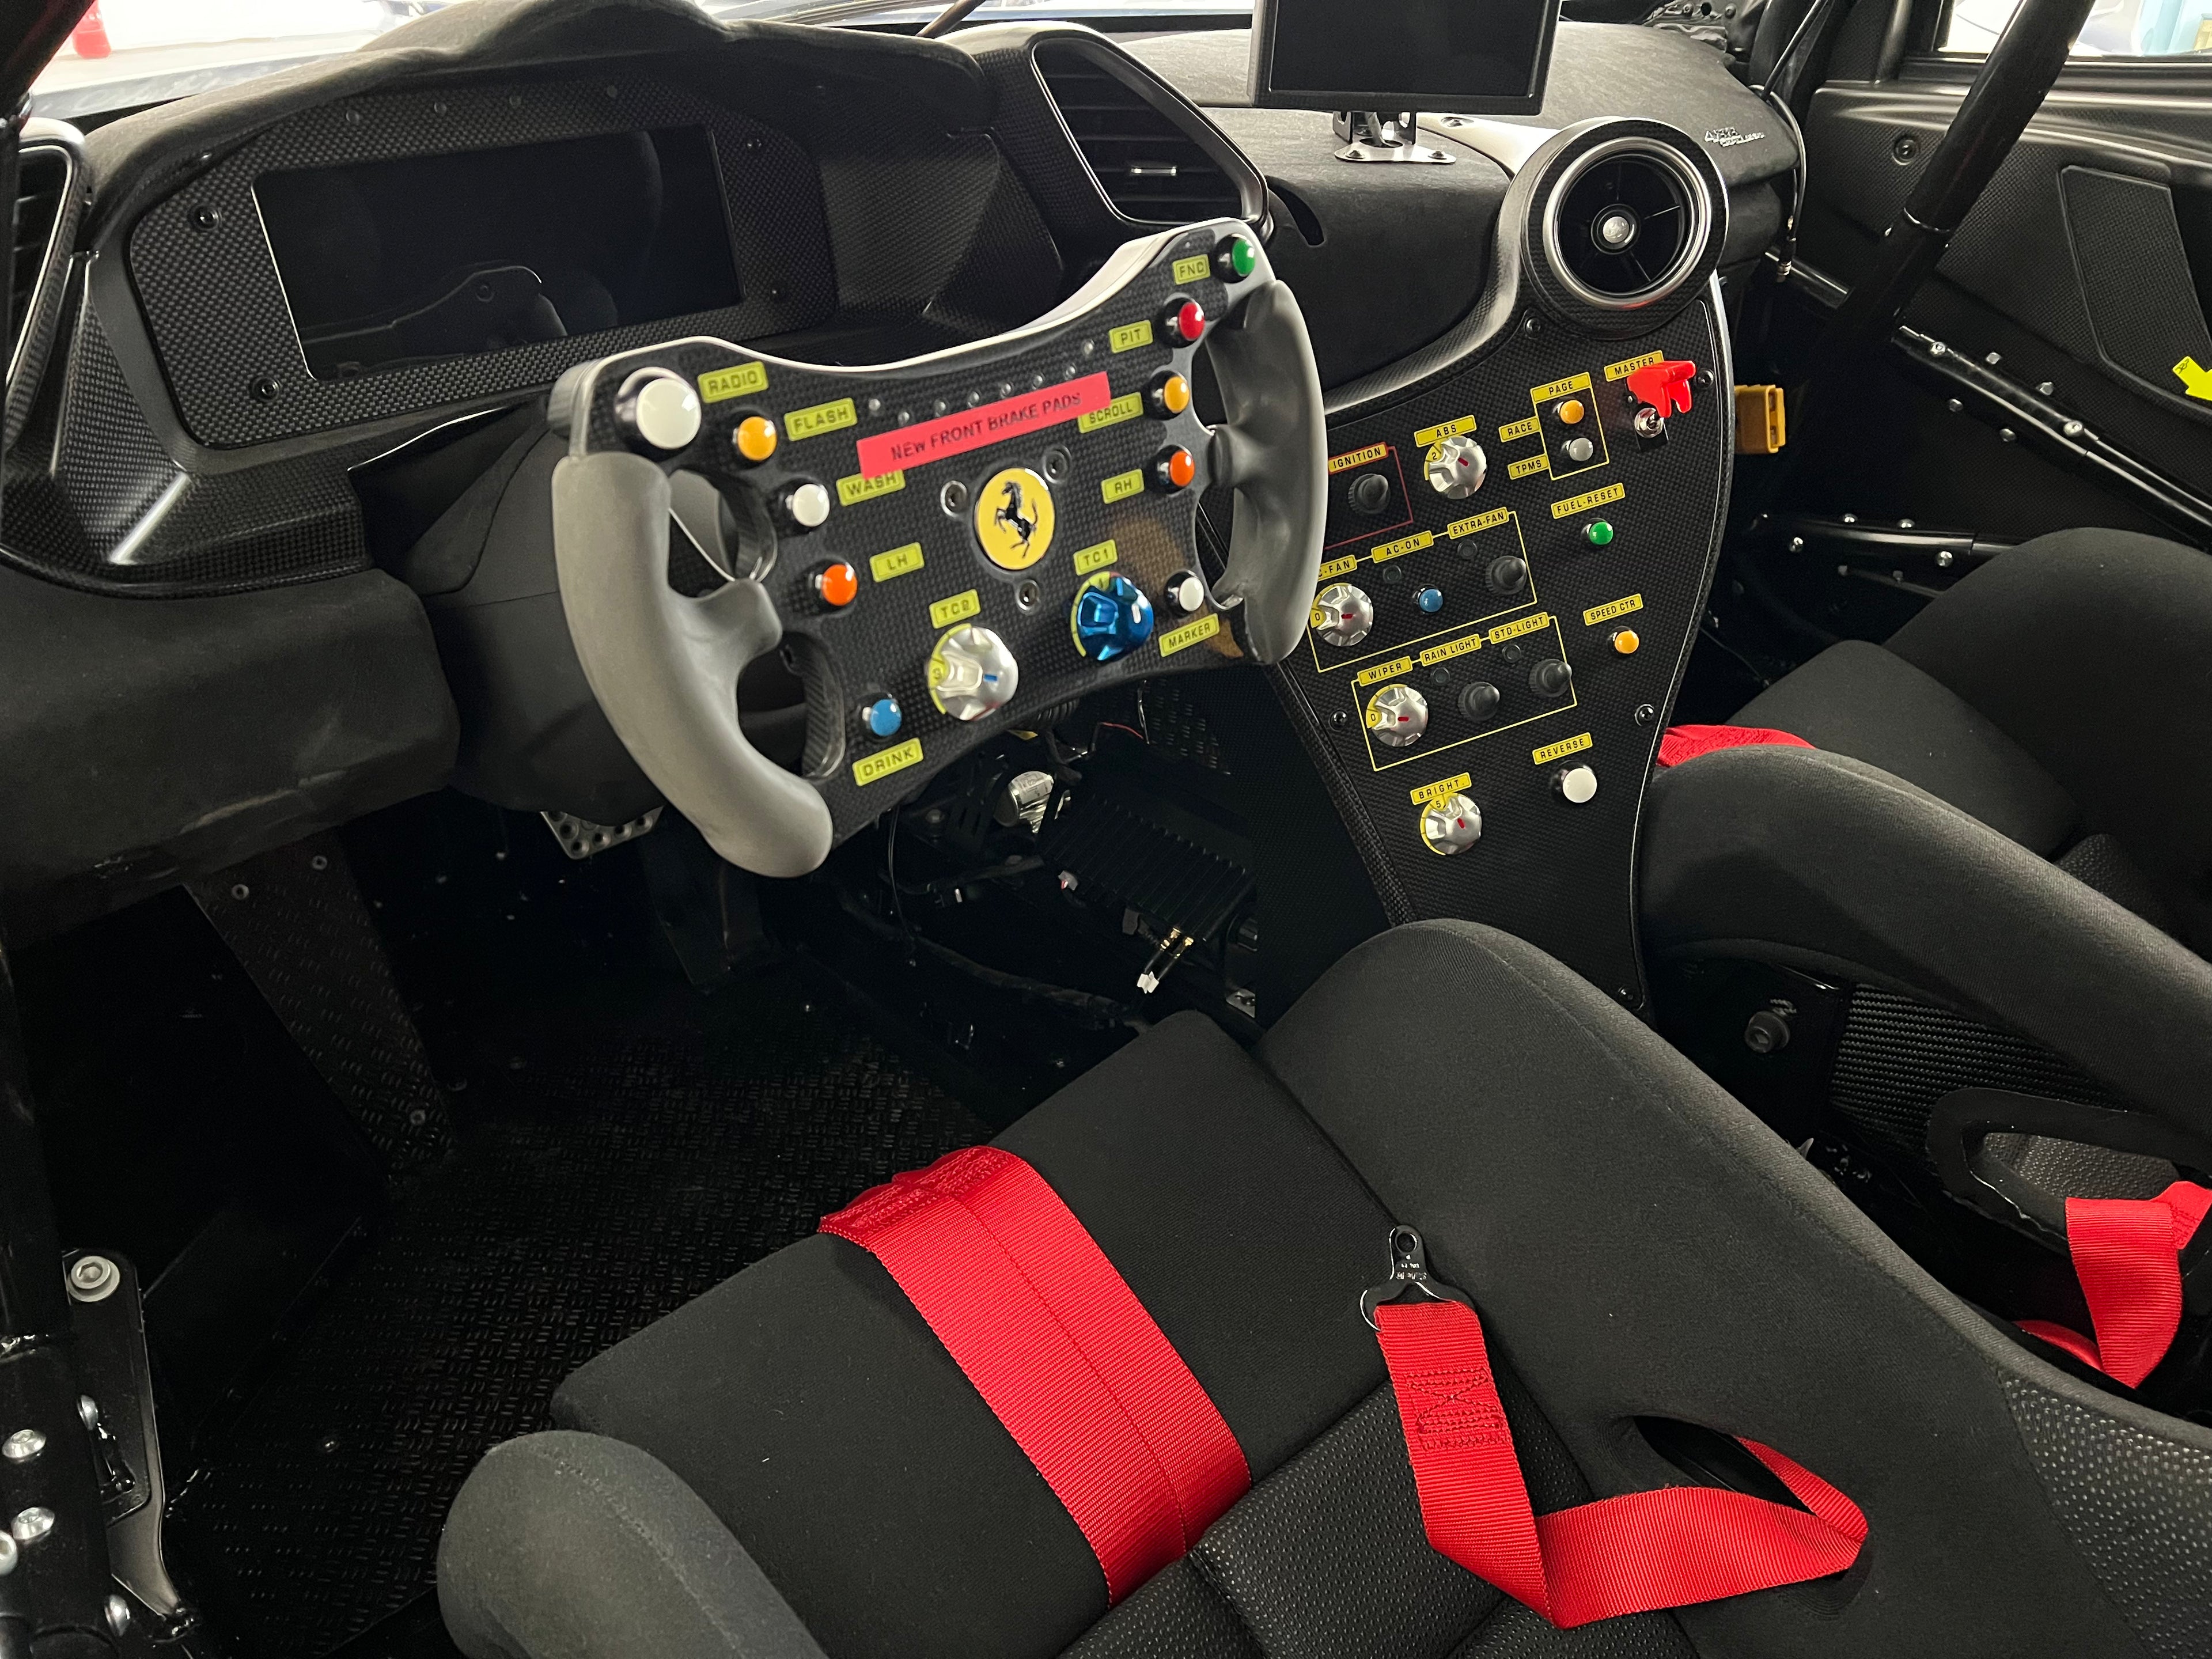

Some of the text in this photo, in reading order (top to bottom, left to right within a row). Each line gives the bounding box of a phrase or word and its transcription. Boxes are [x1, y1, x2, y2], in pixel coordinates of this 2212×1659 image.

[1179, 262, 1204, 278] FNC
[1121, 329, 1141, 345] PIT
[1615, 357, 1654, 376] MASTER
[709, 370, 757, 395] RADIO
[1549, 381, 1573, 396] PAGE
[793, 407, 848, 433] FLASH
[930, 420, 982, 448] FRONT
[988, 404, 1037, 431] BRAKE
[1042, 393, 1082, 414] PADS
[1089, 402, 1132, 424] SCROLL
[1437, 425, 1457, 438] ABS
[1507, 422, 1533, 437] RACE
[1332, 447, 1381, 469] IGNITION
[1432, 452, 1437, 460] 2
[1516, 460, 1541, 474] TPMS
[846, 474, 897, 495] WASH
[1115, 478, 1133, 494] RH
[1557, 488, 1618, 514] FUEL-RESET
[1453, 512, 1504, 535] EXTRA-FAN
[1084, 548, 1109, 566] TC1
[1386, 538, 1421, 556] AC-ON
[887, 553, 908, 571] LH
[1590, 600, 1636, 620] SPEED CTR
[1168, 623, 1210, 649] MARKER
[1495, 617, 1543, 639] STD-LIGHT
[1424, 638, 1476, 662] RAIN LIGHT
[1368, 663, 1402, 680] WIPER
[1540, 738, 1584, 759] REVERSE
[864, 747, 913, 777] DRINK
[1419, 779, 1459, 799] BRIGHT
[1436, 800, 1441, 808] 5
